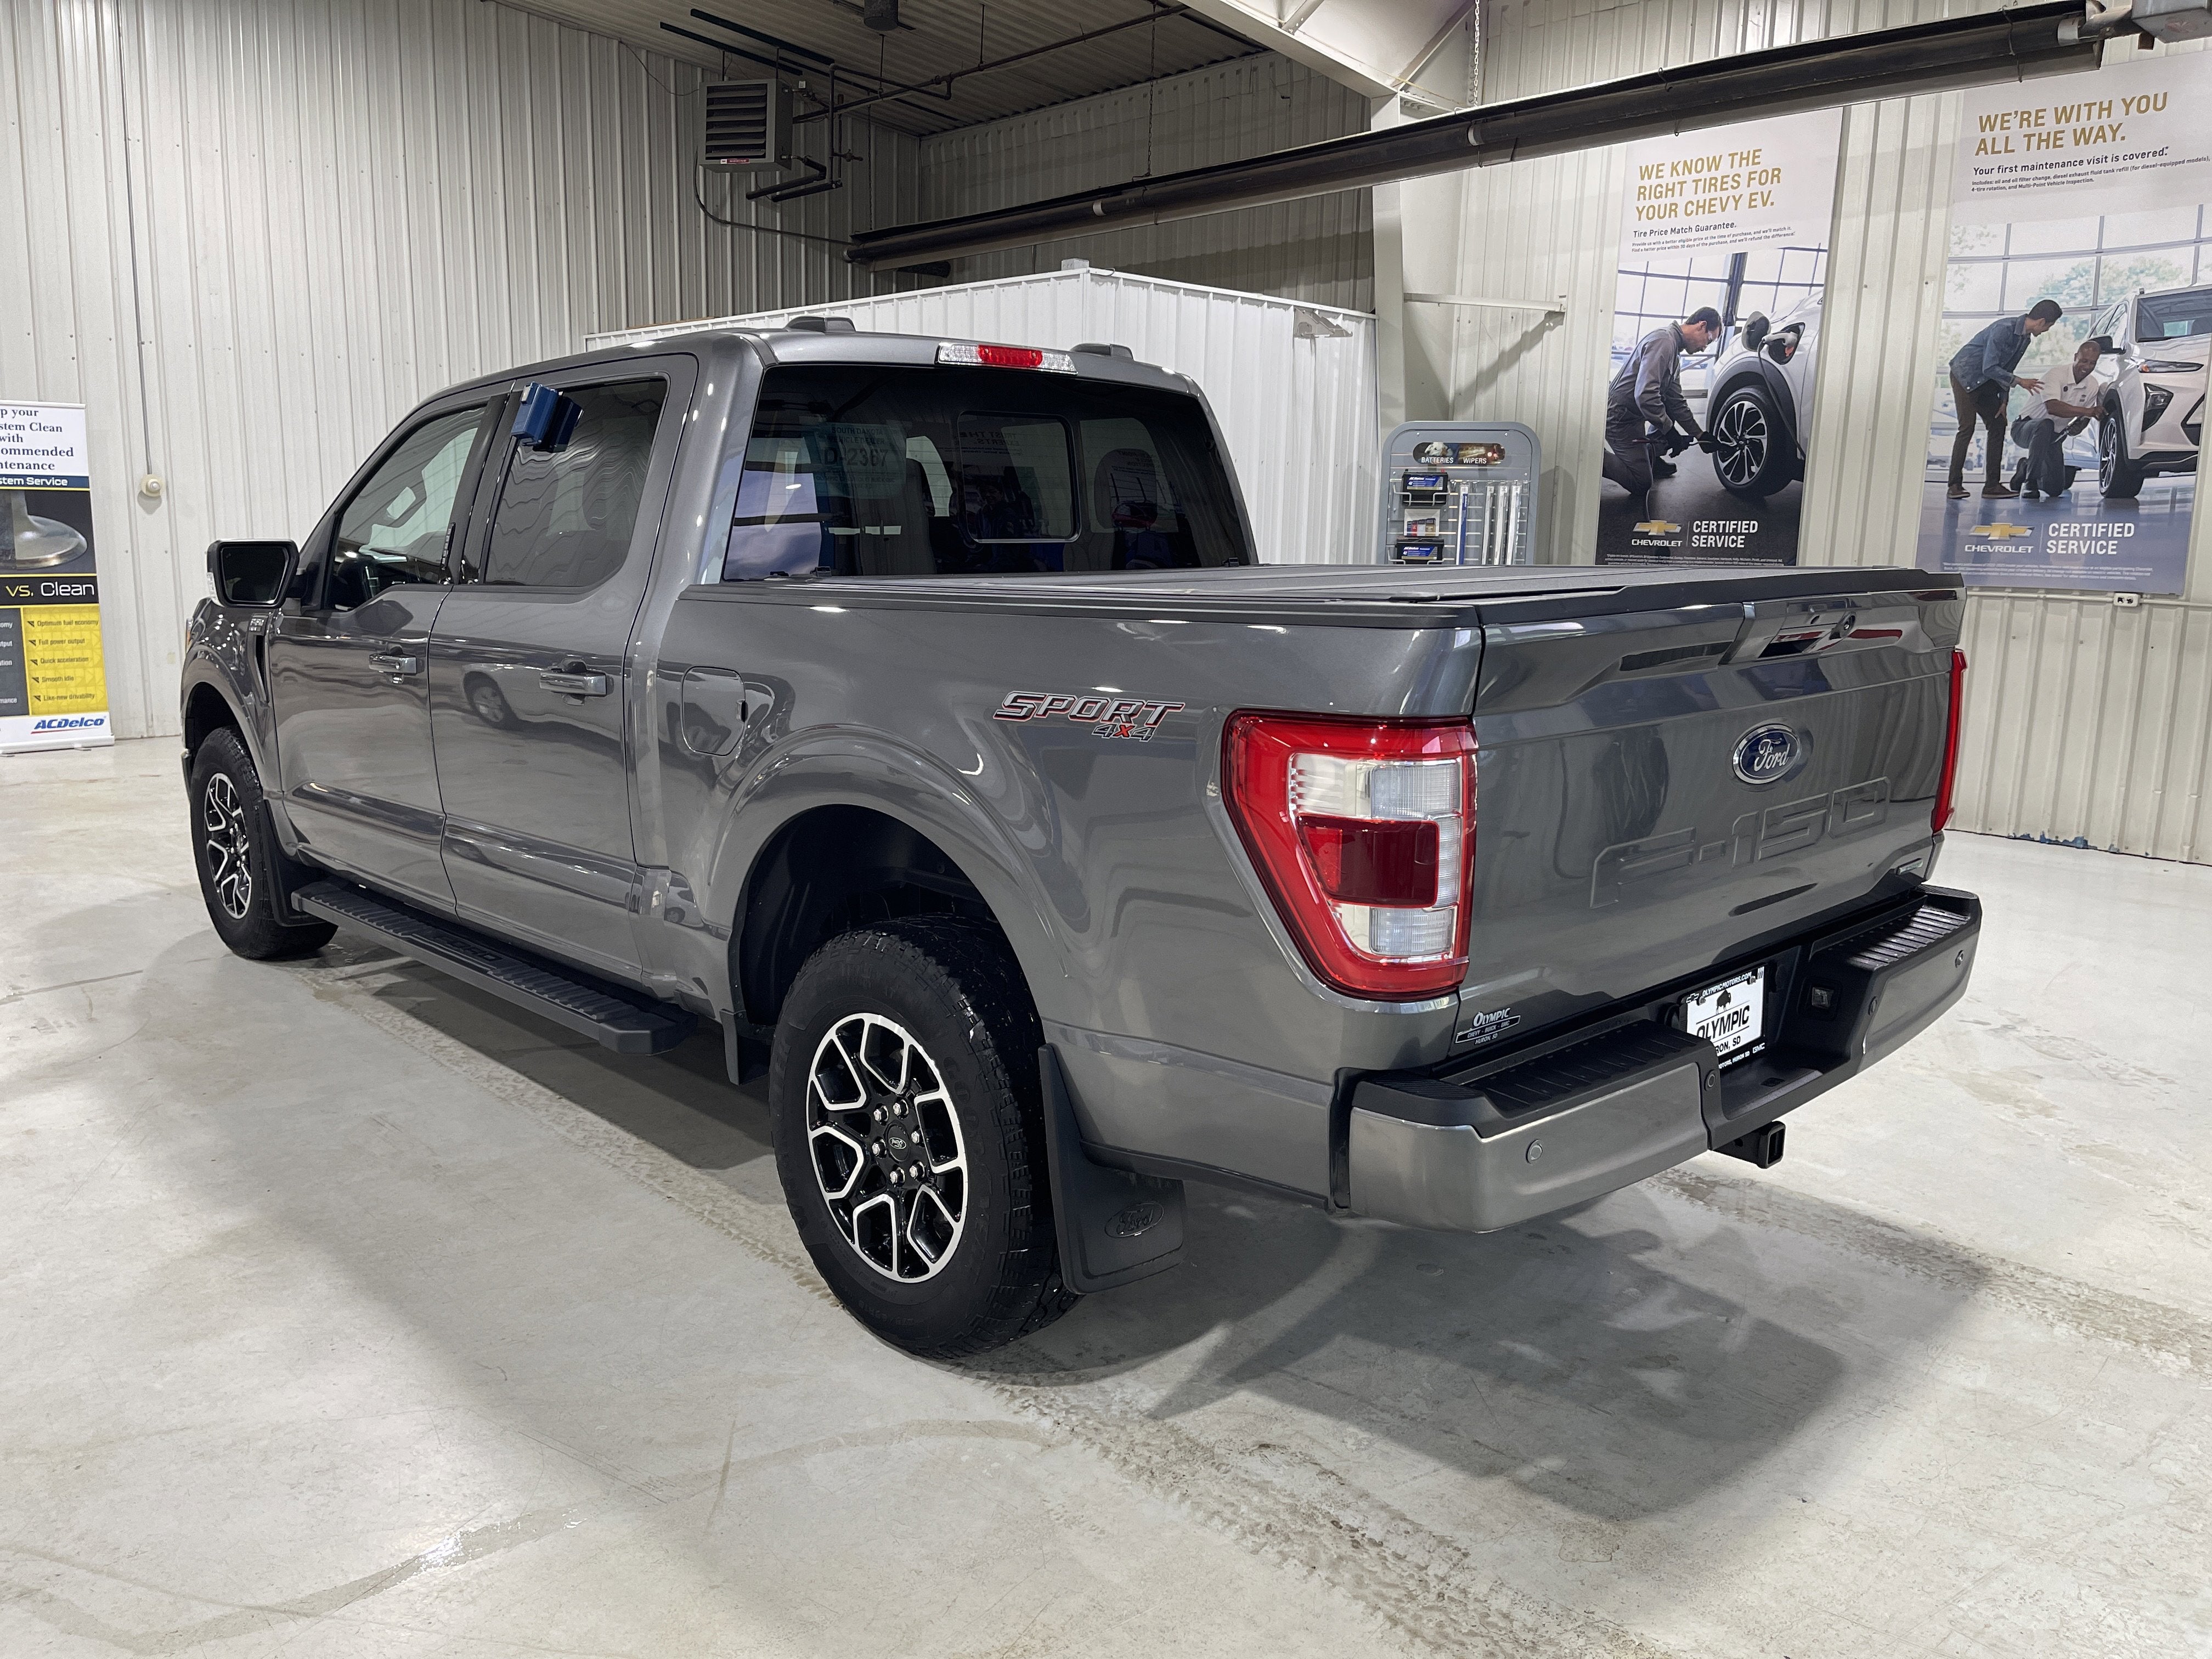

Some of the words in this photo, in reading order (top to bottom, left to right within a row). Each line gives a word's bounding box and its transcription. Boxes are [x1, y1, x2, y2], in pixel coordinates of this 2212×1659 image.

[1978, 108, 2047, 133] WE'RE
[2054, 99, 2113, 125] WITH
[2121, 92, 2168, 116] YOU
[1974, 136, 2015, 156] ALL
[2023, 129, 2066, 151] THE
[2073, 122, 2126, 146] WAY.
[1639, 163, 1665, 180] WE
[1670, 155, 1723, 177] KNOW
[1728, 149, 1762, 168] THE
[1973, 167, 1995, 176] Your
[1997, 165, 2018, 174] first
[2021, 159, 2084, 172] maintenance
[2086, 155, 2108, 165] visit
[2111, 154, 2119, 162] is
[2141, 159, 2185, 170] diesel-equipped
[1637, 180, 1687, 201] RIGHT
[1692, 173, 1741, 195] TIRES
[1747, 167, 1781, 188] FOR
[1636, 202, 1678, 221] YOUR
[1684, 194, 1742, 217] CHEVY
[1748, 190, 1774, 208] EV.
[1670, 225, 1692, 234] Match
[1695, 222, 1737, 232] Guarantee.
[12, 409, 38, 419] your
[30, 422, 63, 432] Clean
[0, 433, 23, 443] with
[1, 447, 74, 456] ommended
[26, 477, 68, 486] Service
[1692, 520, 1759, 533] CERTIFIED
[2048, 523, 2135, 538] CERTIFIED
[1631, 539, 1683, 548] CHEVROLET
[1691, 535, 1745, 548] SERVICE
[1964, 544, 2034, 554] CHEVROLET
[2046, 540, 2118, 555] SERVICE
[41, 582, 95, 597] Clean
[993, 690, 1186, 727] SPORT
[34, 717, 105, 730] ACDelco
[1754, 738, 1790, 771] Ford
[1590, 776, 1891, 910] F-150
[1702, 972, 1752, 997] OLYMPICMOTORS.COM
[1696, 1005, 1751, 1040] OLYMPIC
[1475, 1035, 1491, 1045] HURON
[1733, 1035, 1741, 1047] SD
[1752, 1042, 1765, 1053] GMC
[891, 1138, 903, 1148] Ford
[1116, 1207, 1154, 1235] Ford
